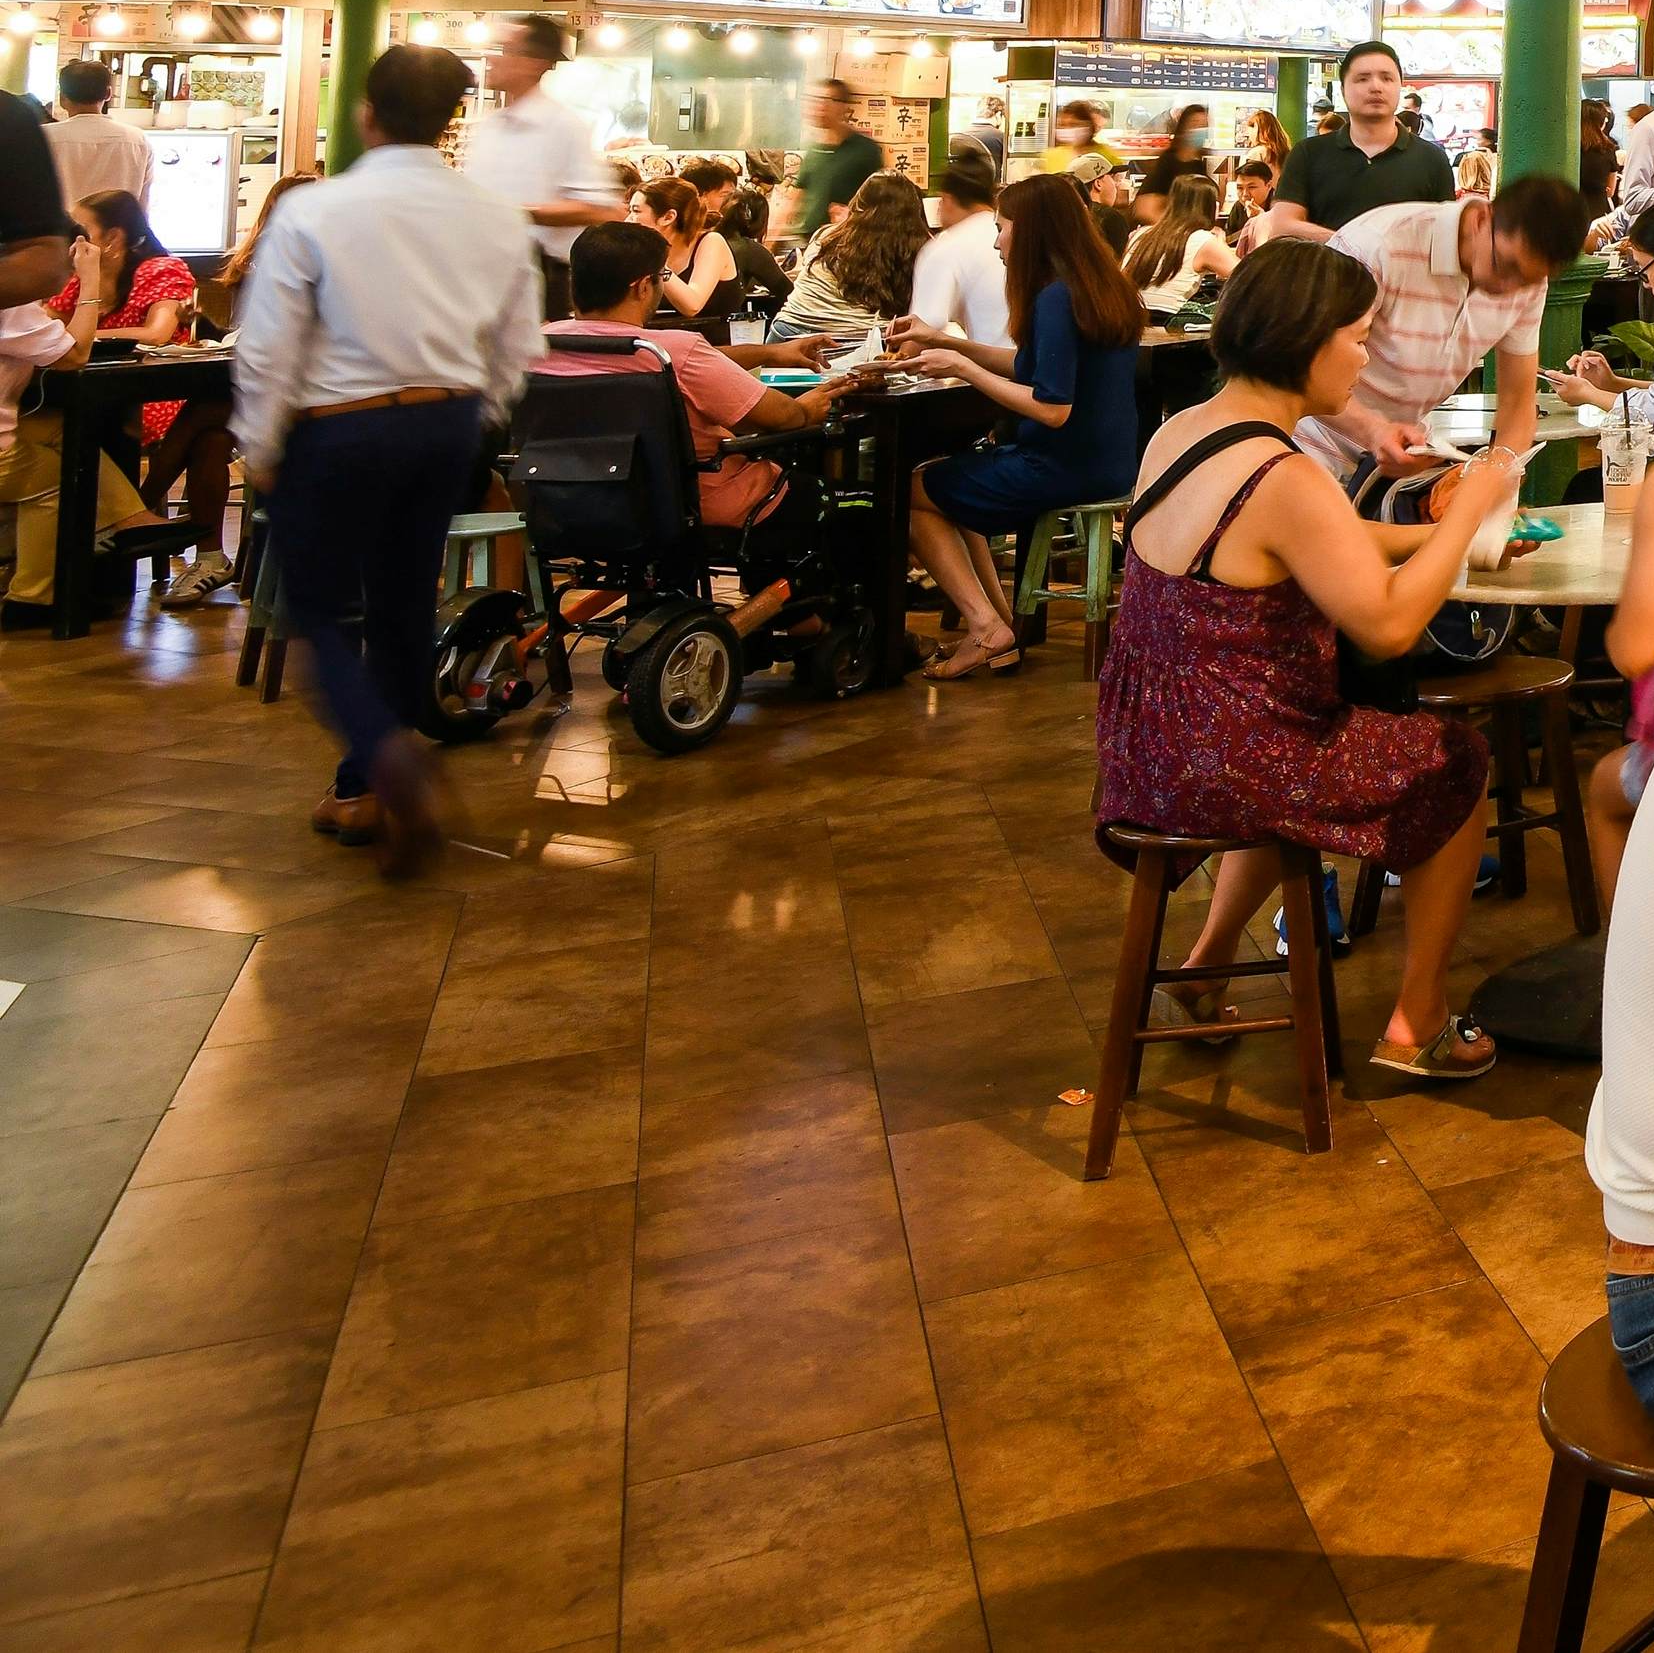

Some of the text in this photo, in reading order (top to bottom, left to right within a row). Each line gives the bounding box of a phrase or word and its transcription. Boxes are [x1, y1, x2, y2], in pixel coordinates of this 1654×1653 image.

[570, 15, 581, 25] 13
[588, 15, 601, 26] 13
[1091, 44, 1100, 53] 15
[1104, 45, 1112, 53] 15
